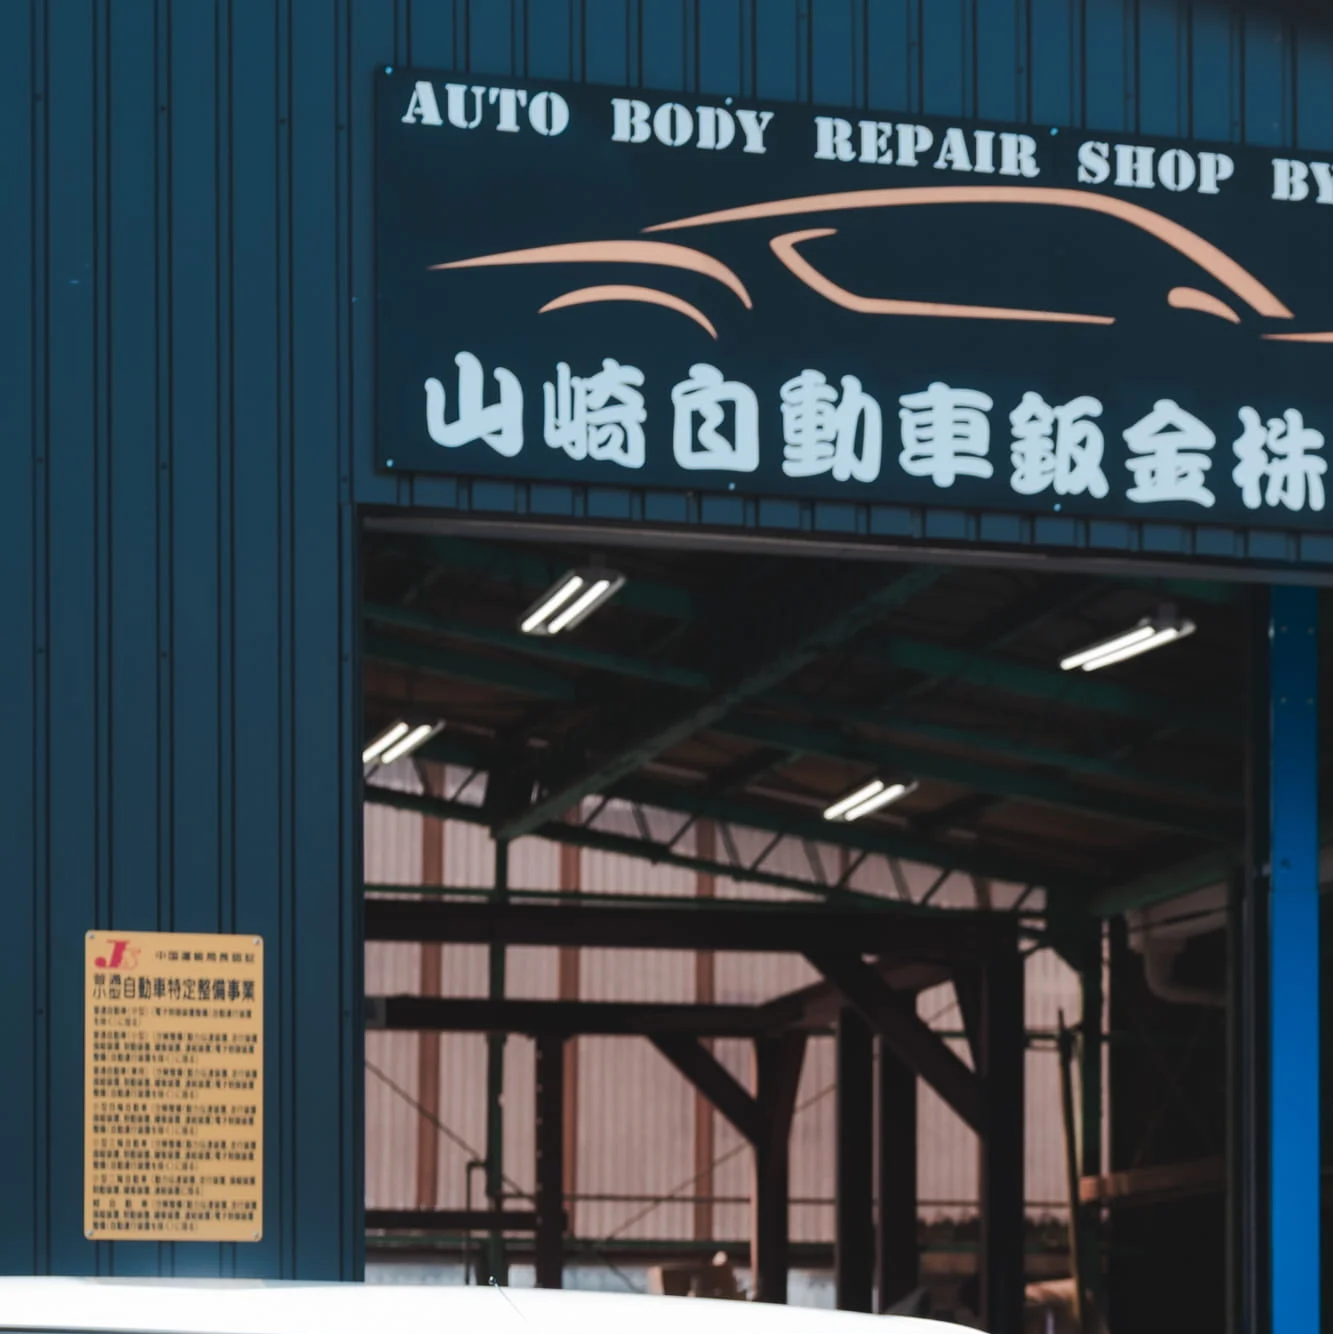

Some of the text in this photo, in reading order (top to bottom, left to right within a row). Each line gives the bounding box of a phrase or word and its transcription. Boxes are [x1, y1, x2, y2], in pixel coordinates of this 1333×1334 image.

[401, 80, 570, 137] AUTO
[611, 98, 775, 154] BODY
[814, 116, 1041, 178] REPAIR
[1077, 140, 1235, 195] SHOP
